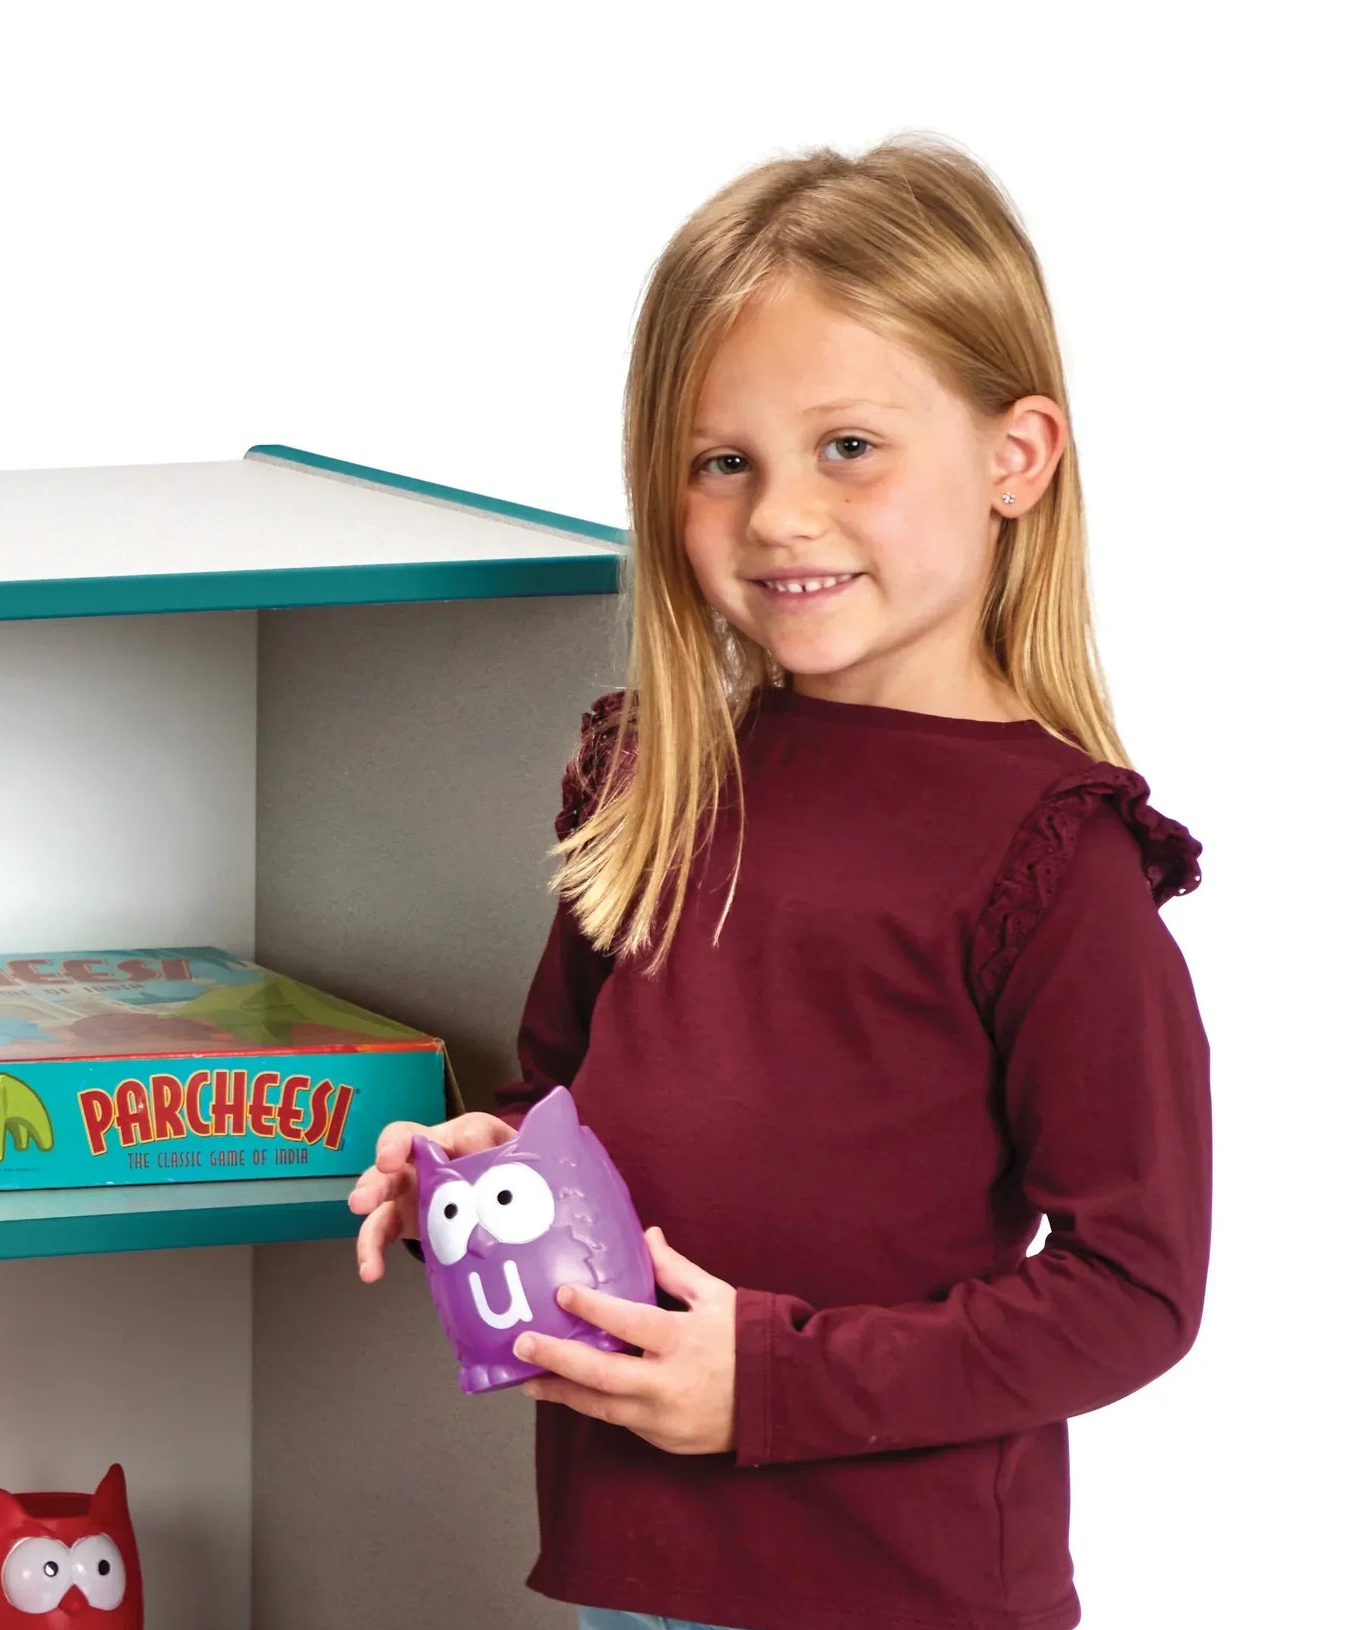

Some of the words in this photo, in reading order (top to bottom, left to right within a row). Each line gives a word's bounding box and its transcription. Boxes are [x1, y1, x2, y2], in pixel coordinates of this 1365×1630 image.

[77, 1069, 354, 1156] PARCHEESI
[128, 1153, 149, 1169] THE
[157, 1151, 202, 1168] CLASSIC
[210, 1150, 245, 1166] GAME
[253, 1149, 267, 1165] OF
[275, 1148, 308, 1164] INDIA
[469, 1260, 533, 1330] u
